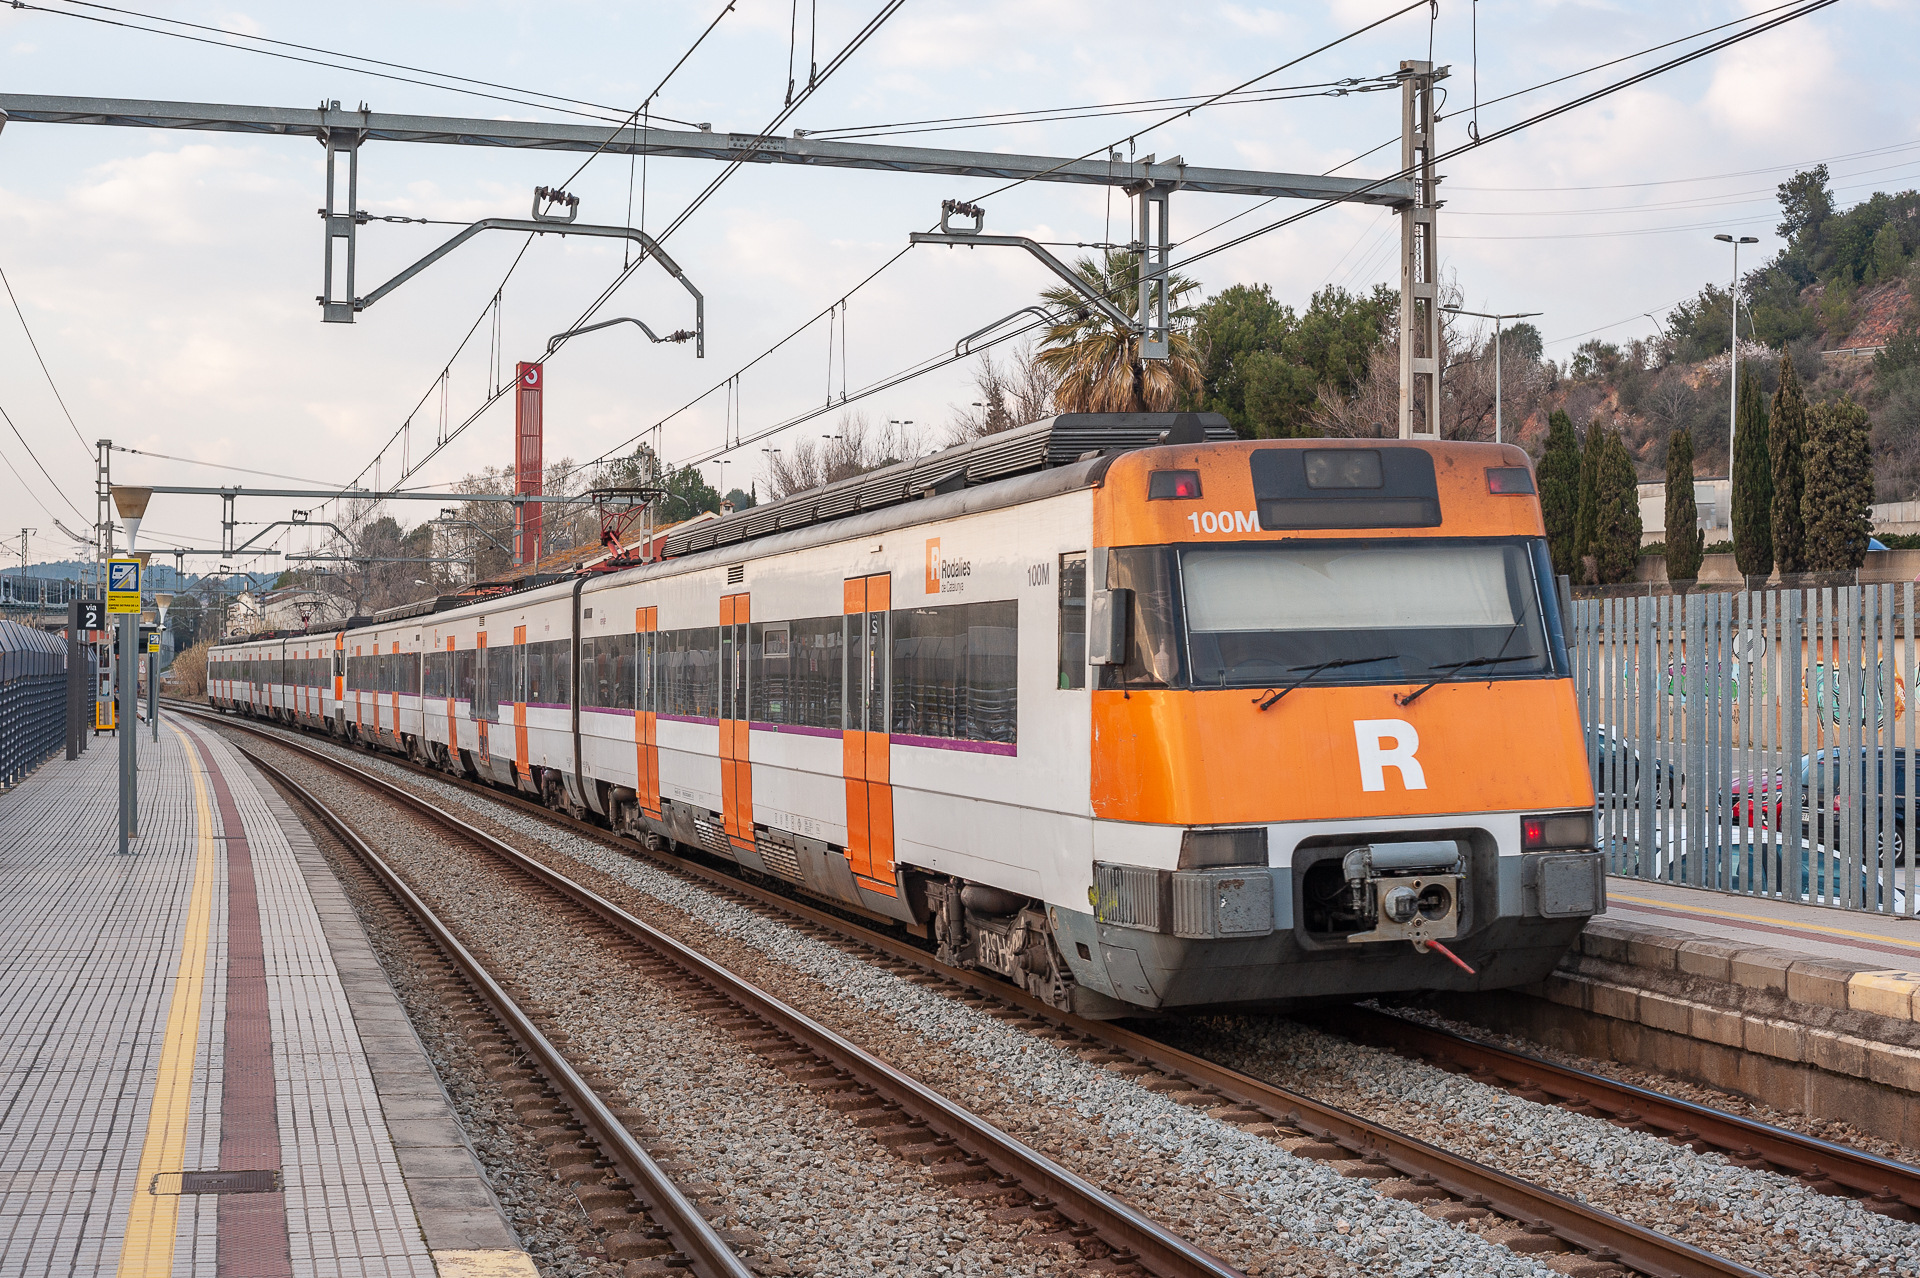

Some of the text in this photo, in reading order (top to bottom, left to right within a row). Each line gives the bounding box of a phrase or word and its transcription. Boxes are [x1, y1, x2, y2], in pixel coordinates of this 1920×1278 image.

[1187, 510, 1261, 533] 100M
[941, 557, 971, 579] Rodalies
[1027, 563, 1050, 587] 100M
[86, 612, 97, 627] 2
[1353, 718, 1428, 792] R
